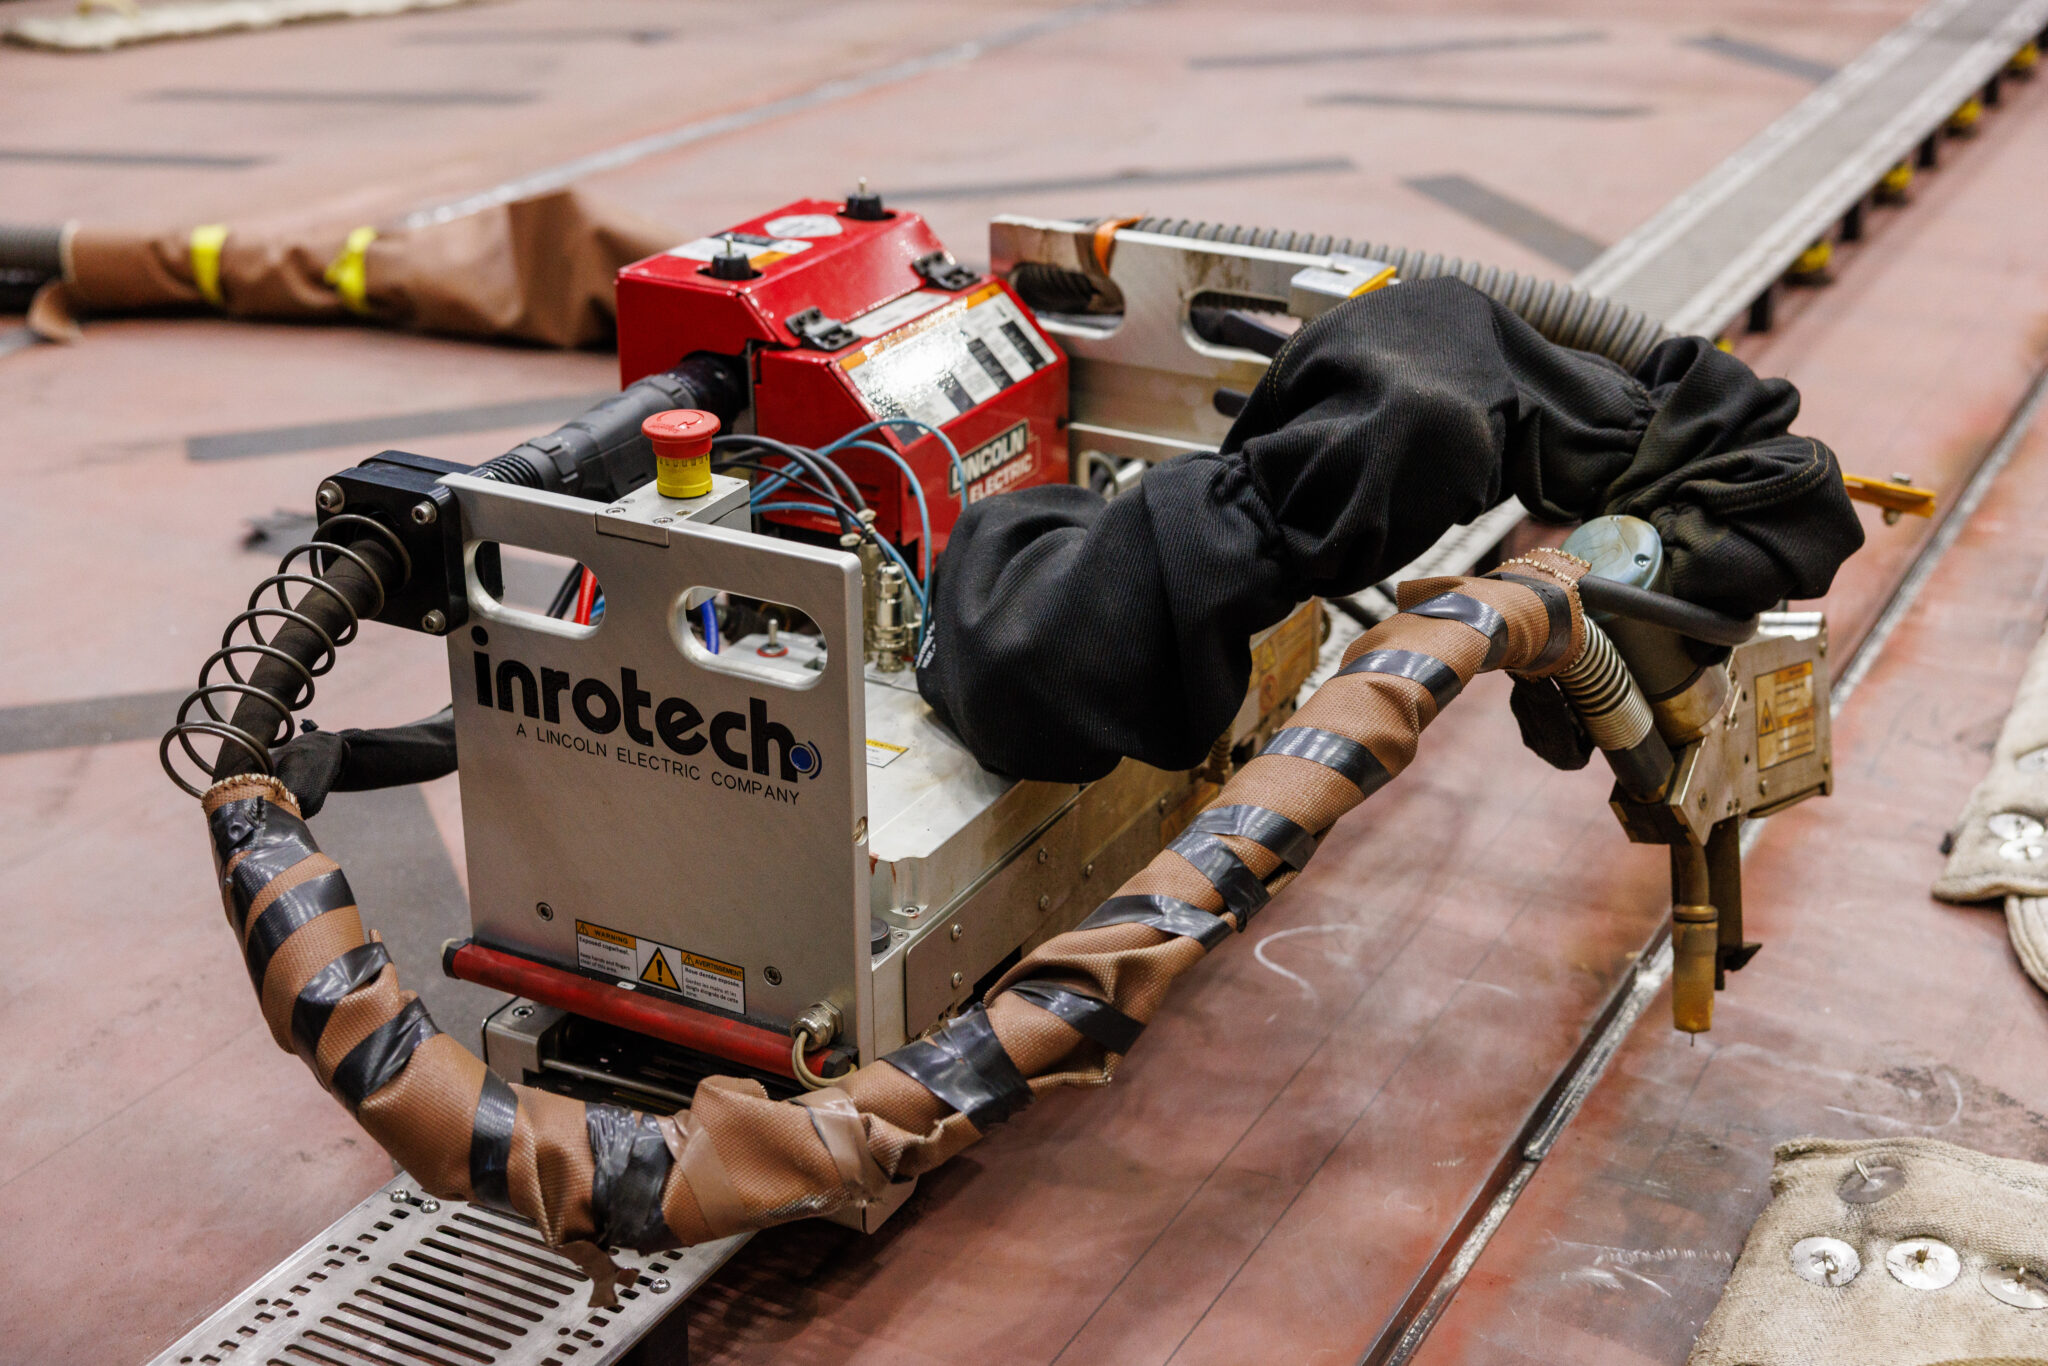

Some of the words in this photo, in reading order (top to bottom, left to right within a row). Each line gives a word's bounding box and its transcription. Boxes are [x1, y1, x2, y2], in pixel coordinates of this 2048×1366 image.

[969, 453, 1033, 504] ELECTRIC
[471, 625, 799, 783] inrotech
[516, 723, 527, 738] A
[537, 727, 607, 757] LINCOLN
[617, 747, 700, 780] ELECTRIC
[712, 772, 799, 805] COMPANY
[594, 929, 628, 944] WARNING
